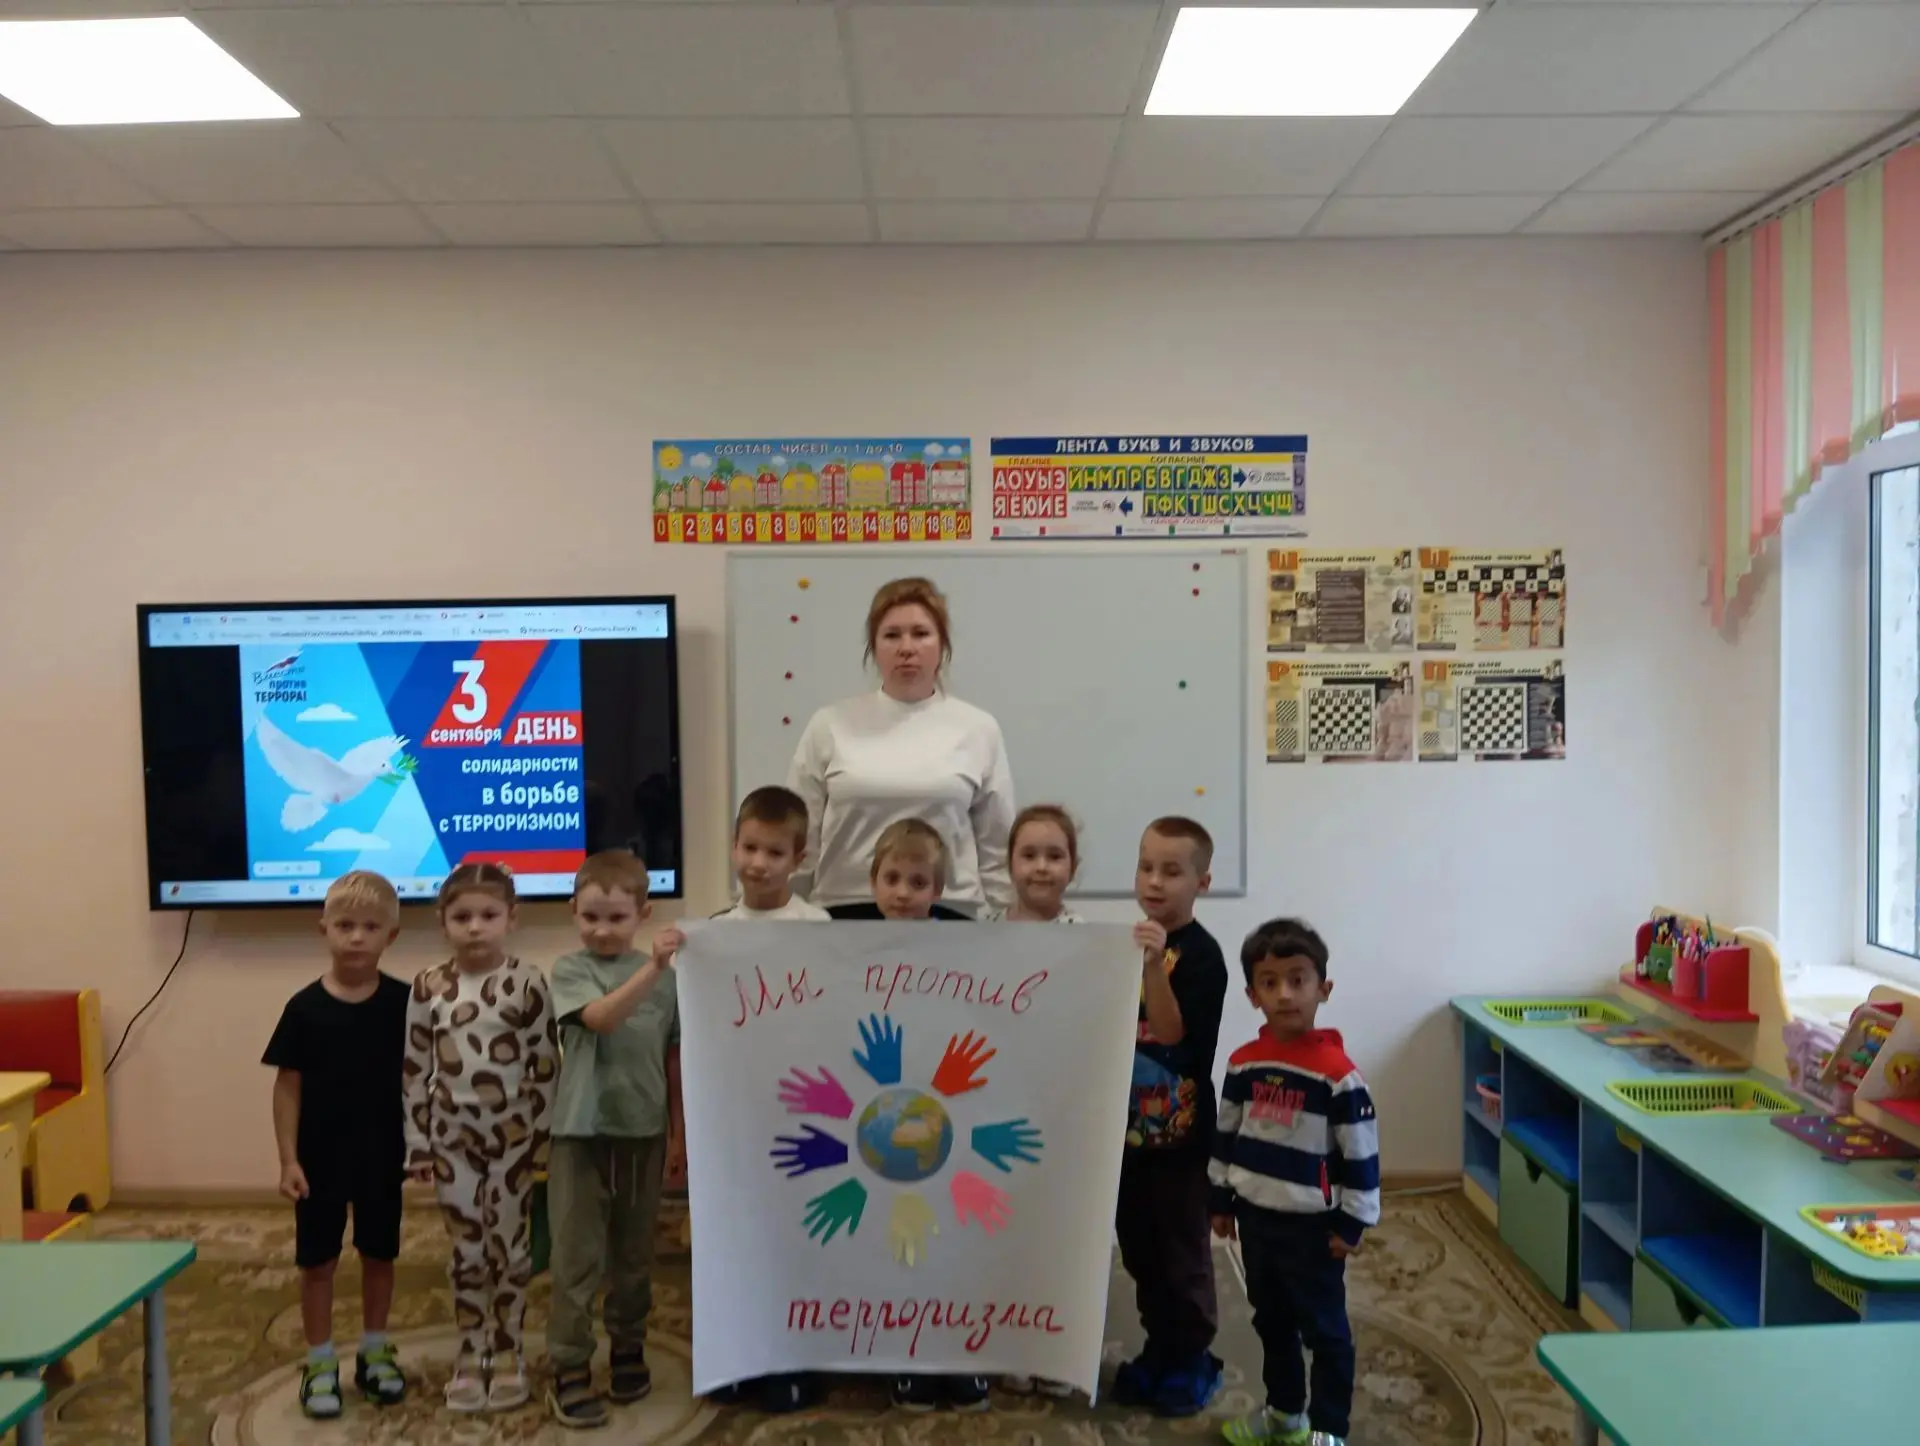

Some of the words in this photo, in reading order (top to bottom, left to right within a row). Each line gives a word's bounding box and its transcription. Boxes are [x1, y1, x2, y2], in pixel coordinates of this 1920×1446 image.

[713, 443, 771, 455] СОСТАВ
[781, 443, 828, 455] ЧИСЕЛ
[1056, 439, 1109, 453] ЛЕНТА
[1118, 438, 1160, 452] БУКВ
[1169, 438, 1181, 452] И
[1191, 437, 1255, 452] ЗВУКОВ
[657, 518, 665, 536] 0
[685, 518, 695, 536] 2
[715, 518, 724, 536] 4
[744, 518, 754, 536] 6
[774, 518, 783, 536] 8
[801, 517, 816, 535] 10
[832, 517, 846, 535] 12
[864, 517, 877, 534] 14
[894, 517, 909, 534] 16
[926, 516, 940, 534] 18
[957, 516, 970, 534] 20
[269, 680, 307, 690] против
[451, 659, 489, 724] 3
[255, 691, 307, 702] ТЕРРОРА!
[430, 725, 502, 744] сентября
[514, 716, 577, 744] ДЕНЬ
[461, 755, 579, 776] солидарности
[482, 786, 495, 805] в
[500, 782, 580, 809] борьбе
[439, 819, 450, 832] с
[452, 811, 580, 833] ТЕРРОРИЗМОМ
[732, 965, 824, 1028] Мы
[864, 961, 1049, 1015] против
[787, 1296, 1065, 1358] терроризма
